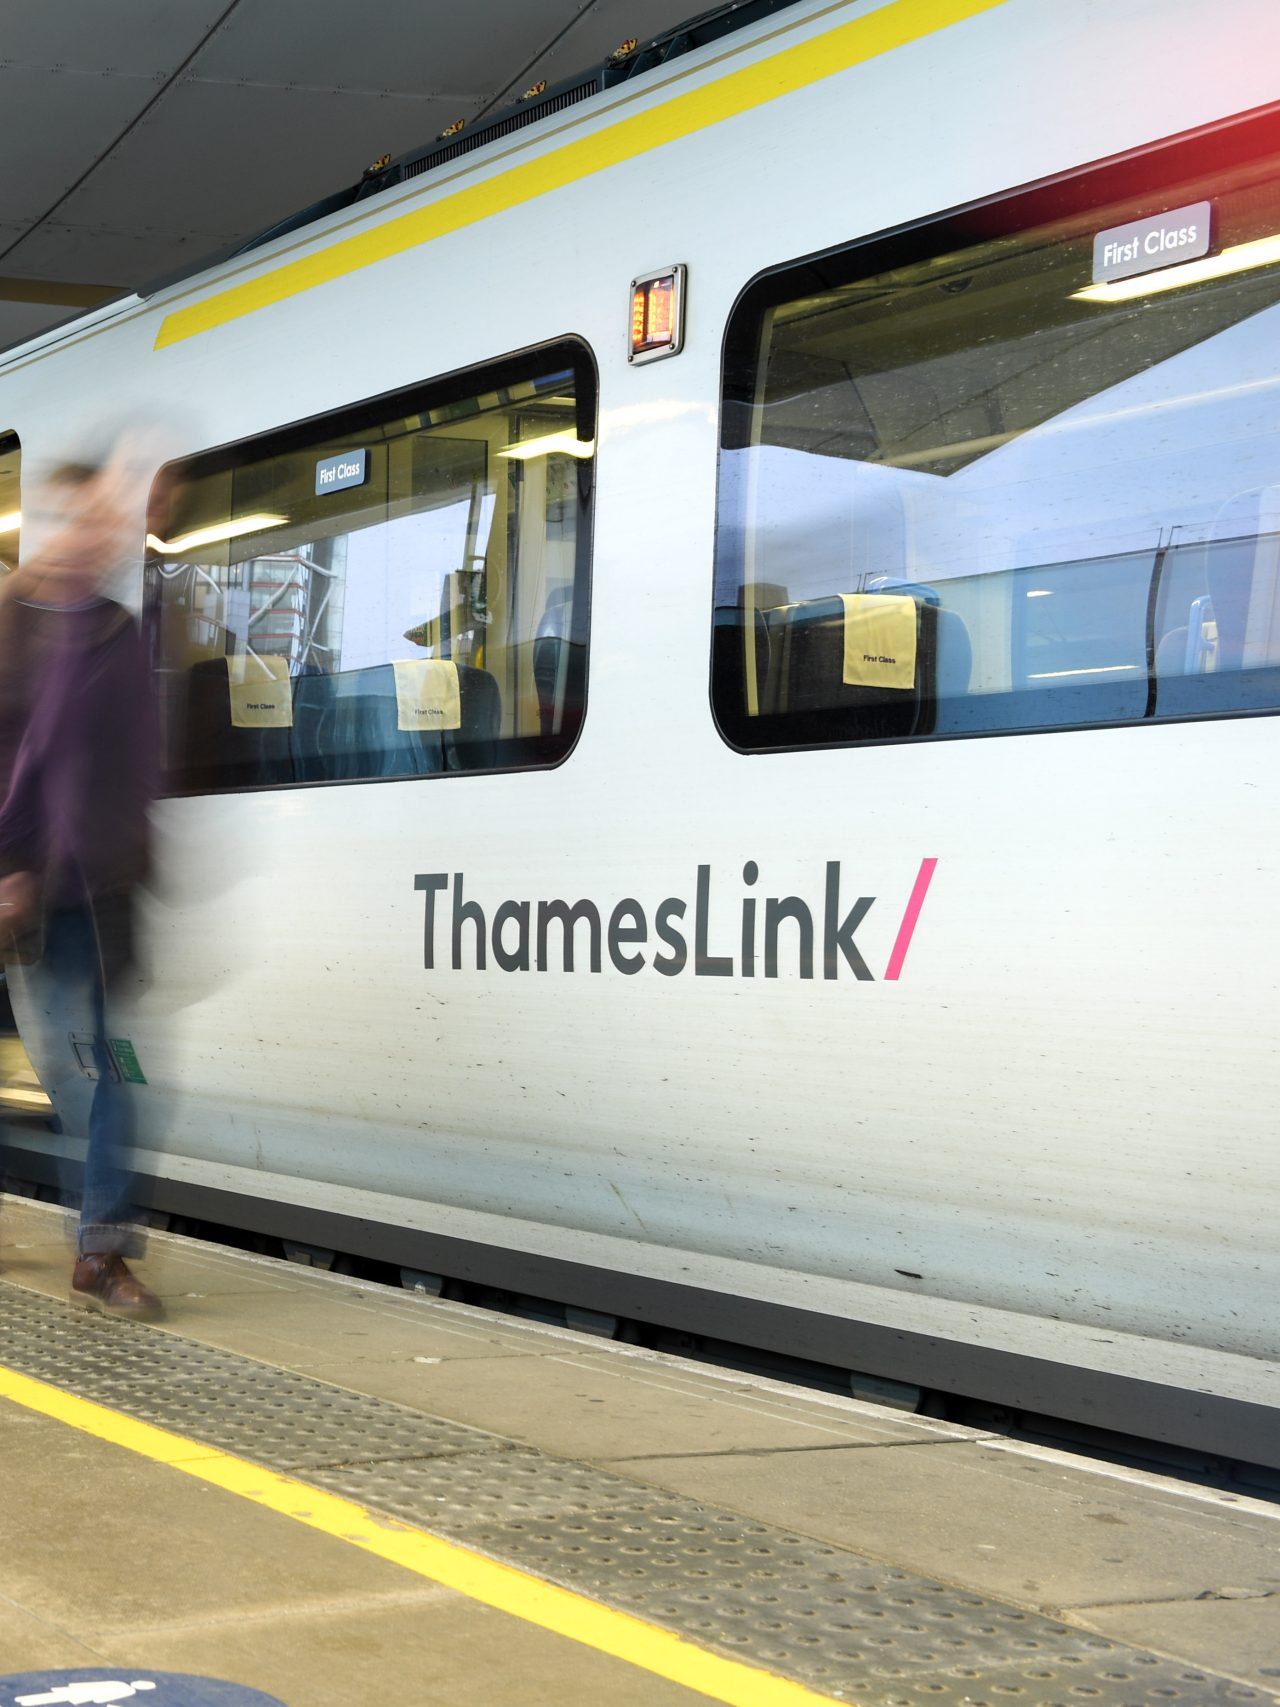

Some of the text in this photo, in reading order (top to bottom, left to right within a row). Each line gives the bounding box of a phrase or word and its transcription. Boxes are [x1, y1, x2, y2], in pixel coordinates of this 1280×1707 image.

[1103, 225, 1198, 267] First Class
[320, 463, 360, 485] First Class
[863, 654, 896, 664] First Class
